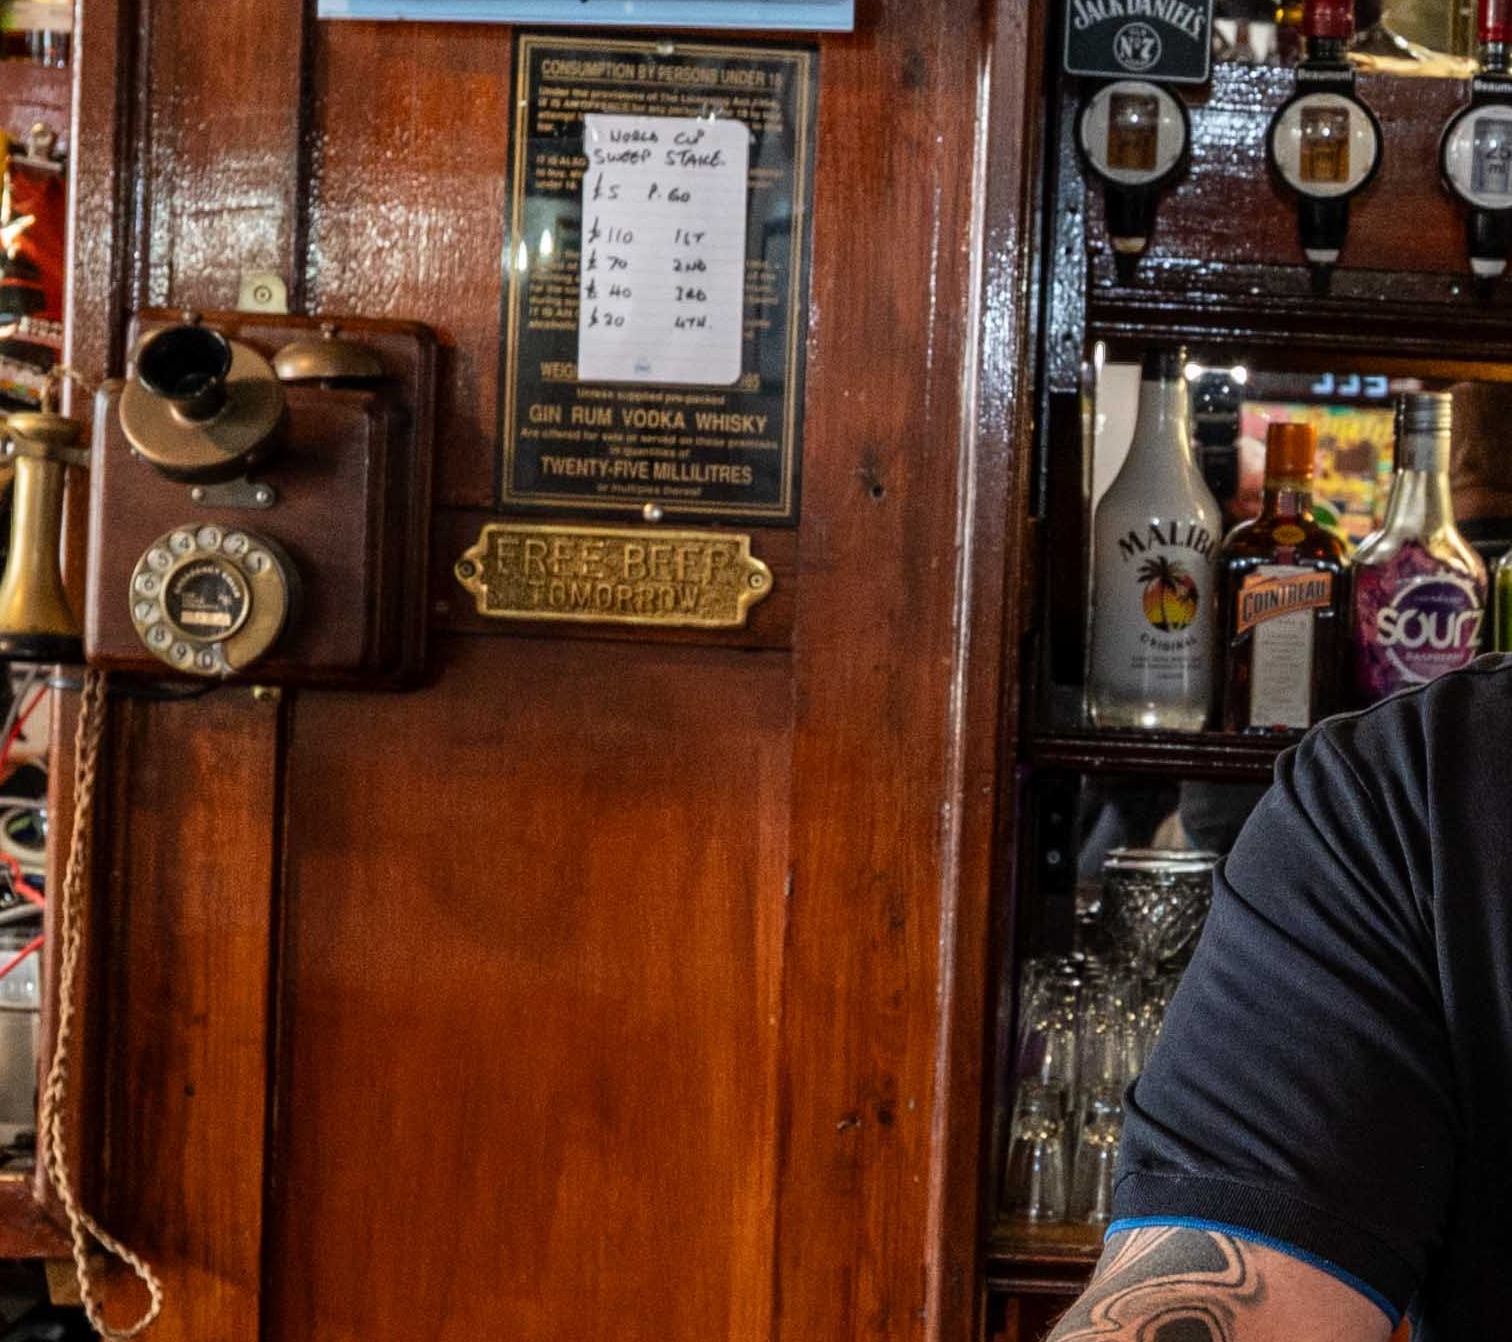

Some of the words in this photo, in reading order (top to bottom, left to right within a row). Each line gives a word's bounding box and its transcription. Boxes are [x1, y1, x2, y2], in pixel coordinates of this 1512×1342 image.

[542, 60, 636, 78] CONSUMPTION
[638, 63, 656, 79] BY
[658, 64, 718, 83] PERSONS
[721, 69, 765, 84] UNDER
[594, 149, 651, 165] SWEEP
[529, 405, 561, 423] GIN
[572, 406, 612, 425] RUM
[623, 409, 684, 429] VODKA
[696, 413, 767, 434] WHISKY
[542, 456, 650, 478] TWENTY-FIVE
[653, 462, 753, 484] MILLILITRES
[497, 538, 605, 579] FREE
[622, 543, 730, 585] BEER
[527, 580, 699, 611] TOMORROW
[1241, 578, 1328, 622] COINTREAU
